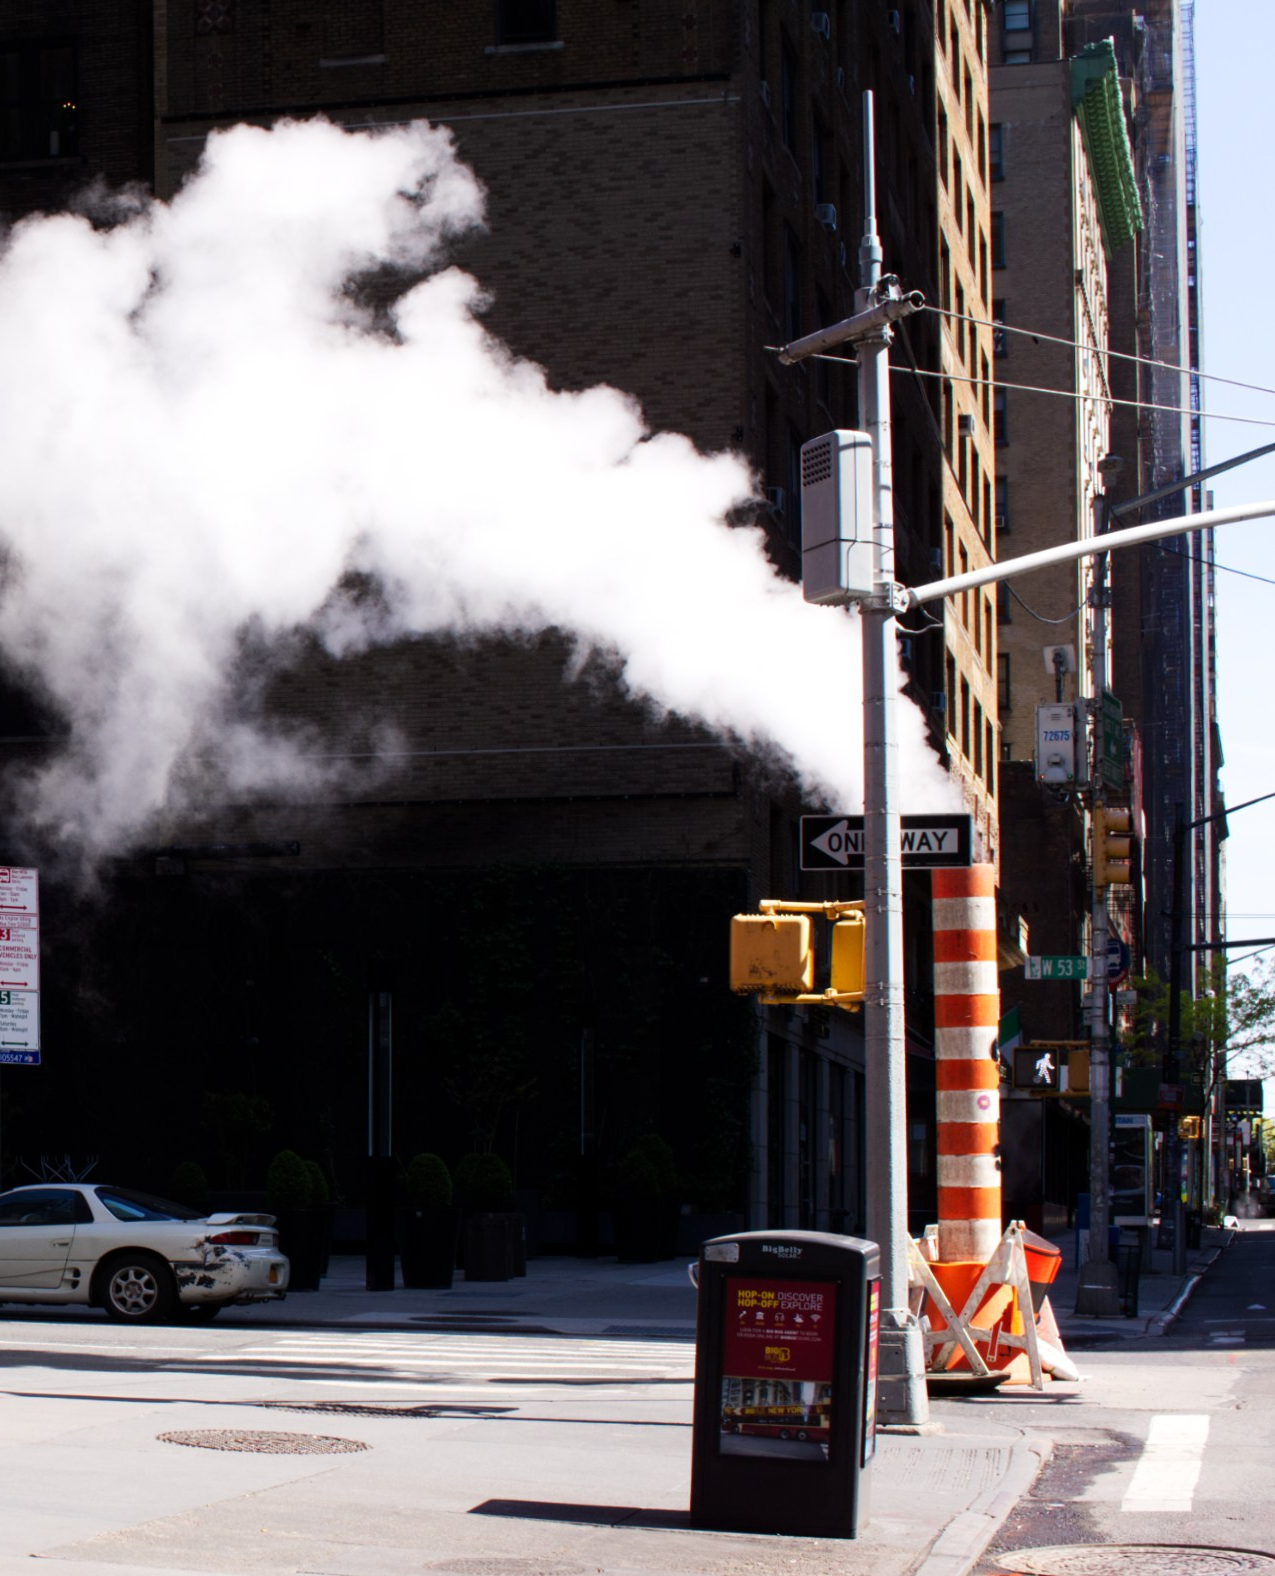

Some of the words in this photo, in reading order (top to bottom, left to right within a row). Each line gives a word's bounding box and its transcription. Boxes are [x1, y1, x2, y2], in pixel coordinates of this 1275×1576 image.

[1043, 730, 1070, 741] 72675
[828, 832, 864, 853] ON
[0, 928, 8, 940] 3
[1042, 959, 1053, 976] W
[1057, 959, 1073, 976] 53
[1077, 960, 1085, 970] St
[0, 991, 8, 1004] 5
[762, 1245, 803, 1255] BigBelly
[738, 1290, 774, 1300] HOP-ON
[777, 1292, 823, 1303] DISCOVER
[738, 1299, 779, 1309] HOP-OFF
[781, 1301, 823, 1312] EXPLORE
[765, 1346, 779, 1354] BIG
[768, 1407, 785, 1415] NEW
[786, 1406, 808, 1414] YORK
